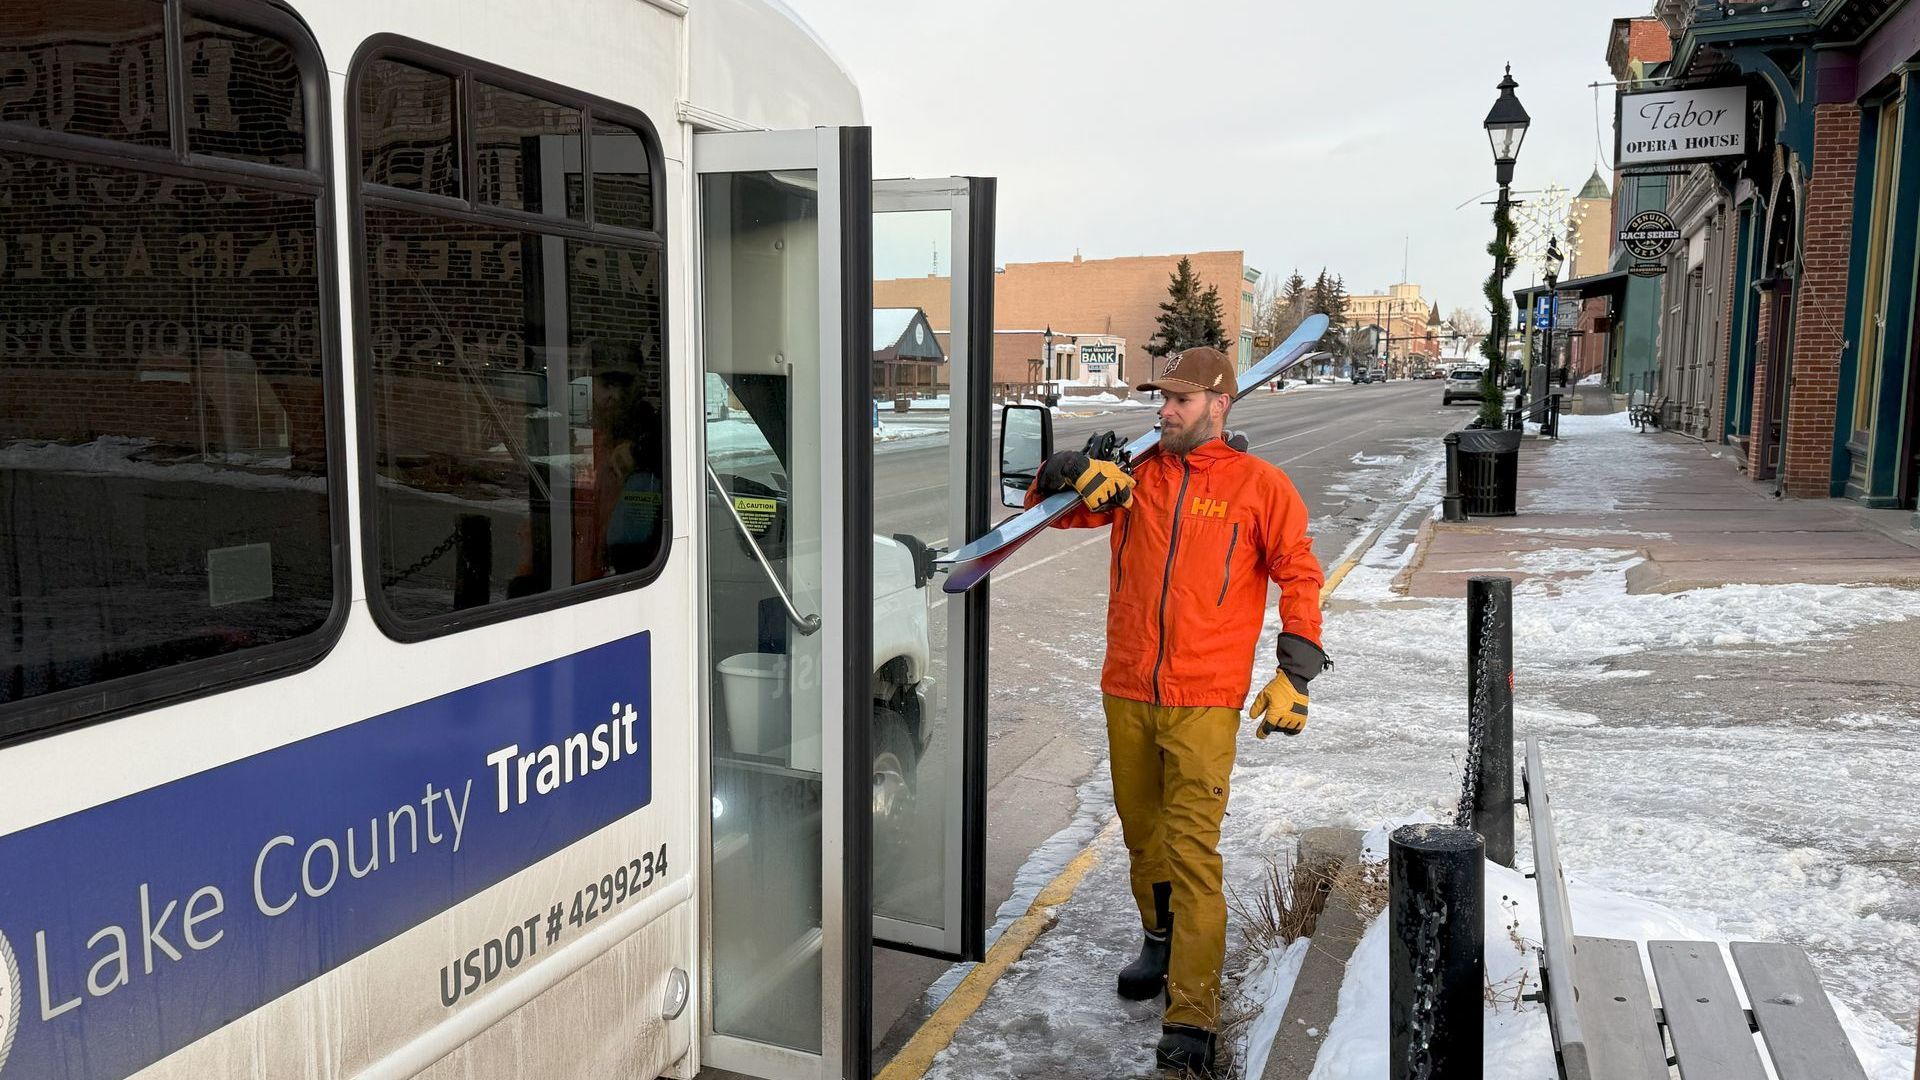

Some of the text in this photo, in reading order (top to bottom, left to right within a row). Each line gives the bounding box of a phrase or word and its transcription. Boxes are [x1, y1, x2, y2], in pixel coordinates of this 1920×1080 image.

[1640, 99, 1728, 131] Tabor
[1626, 133, 1740, 154] OPERA HOUSE
[1632, 214, 1670, 228] GENUINE
[1620, 230, 1680, 240] RACE SERIES
[1634, 247, 1663, 257] GEAR
[1082, 352, 1114, 363] BANK
[1191, 496, 1229, 519] HH
[35, 702, 640, 1022] Lake County Transit
[440, 843, 669, 1008] USDOT # 4299234
